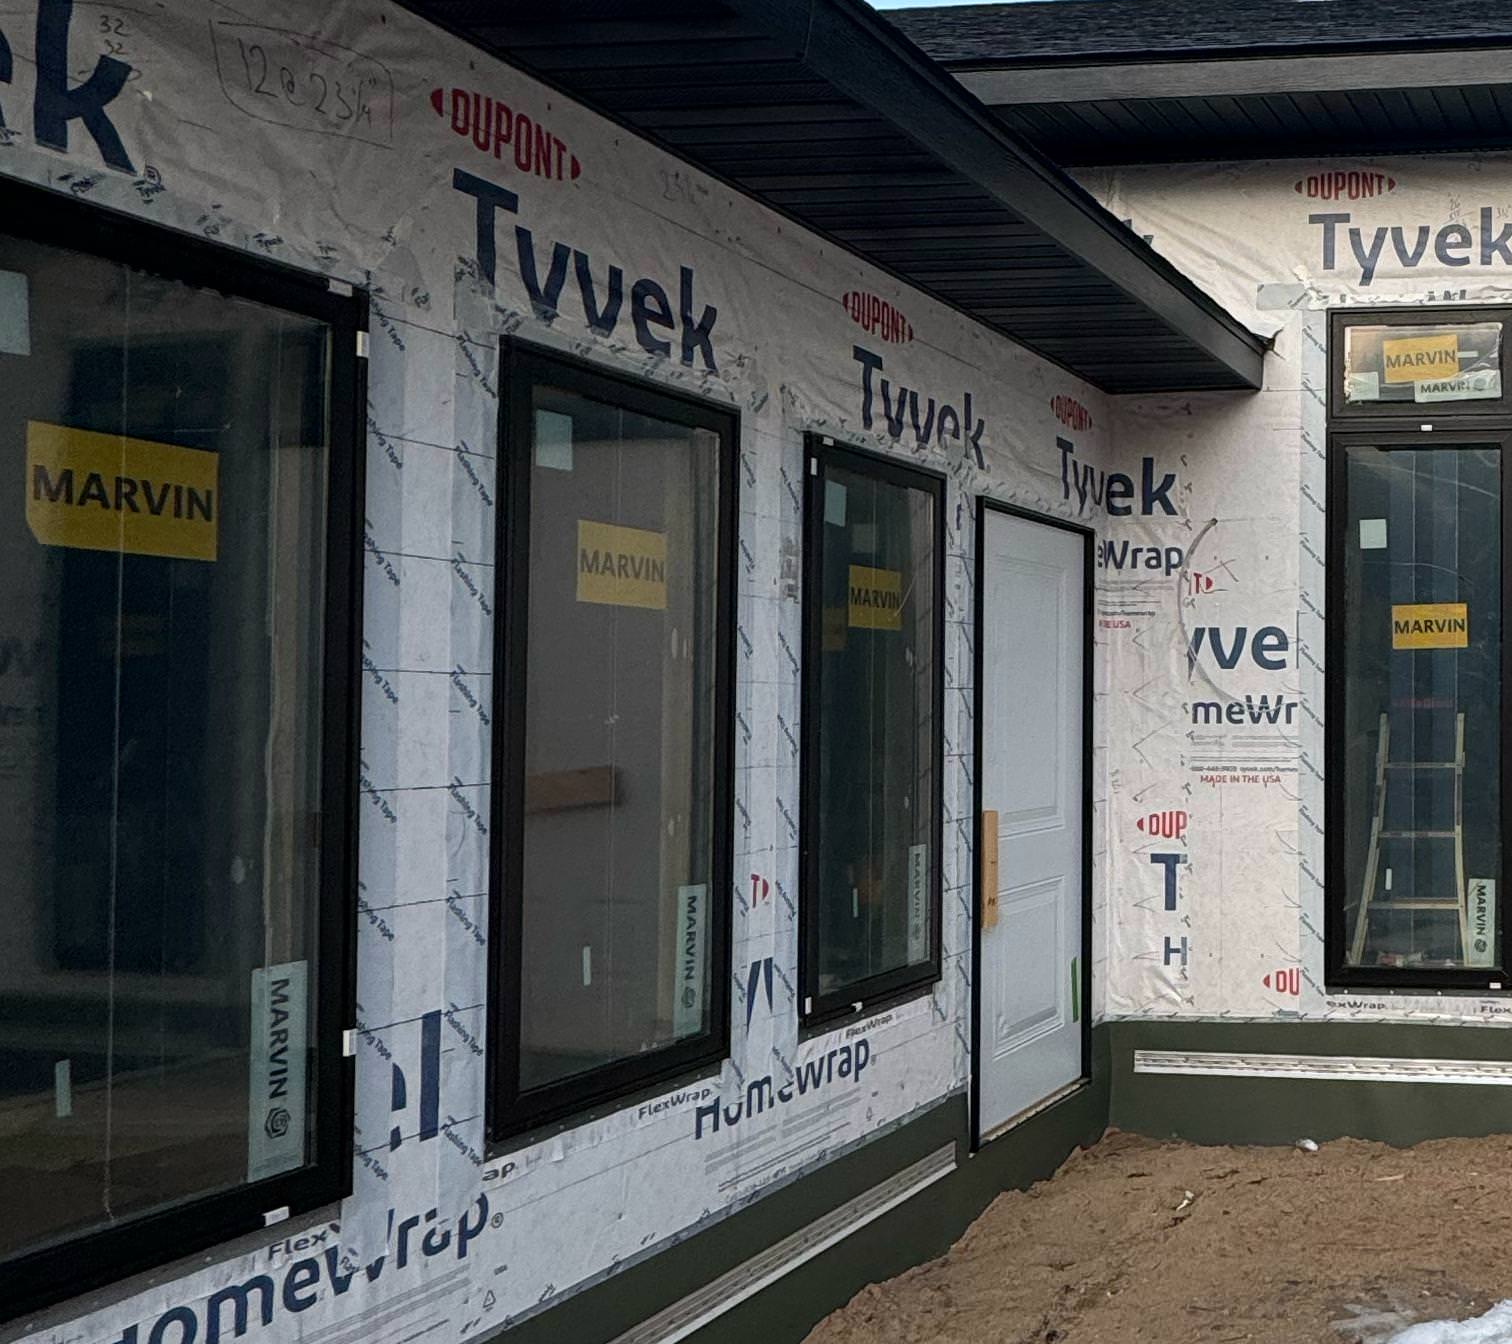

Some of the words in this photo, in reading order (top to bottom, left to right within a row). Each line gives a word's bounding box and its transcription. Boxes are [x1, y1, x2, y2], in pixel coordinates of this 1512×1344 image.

[450, 88, 567, 180] DUPONT
[1307, 170, 1386, 201] DUPONT
[851, 291, 906, 344] DUPONT
[1386, 350, 1457, 369] MARVIN
[1055, 395, 1089, 432] DUPONT
[31, 463, 215, 524] MARVIN
[1056, 436, 1178, 516] Tyvek
[579, 550, 665, 584] MARVIN
[850, 587, 900, 611] MARVIN
[1394, 618, 1466, 634] MARVIN
[1187, 610, 1300, 681] yve
[1200, 775, 1227, 784] MADE
[1229, 775, 1240, 784] IN
[1241, 775, 1261, 784] THE
[1262, 775, 1281, 784] USA
[1149, 811, 1187, 839] DUP
[1477, 884, 1487, 936] MARVIN
[684, 894, 698, 986] MARVIN
[269, 977, 291, 1099] MARVIN
[638, 1088, 711, 1120] FlexWrap
[268, 1222, 341, 1261] Flex
